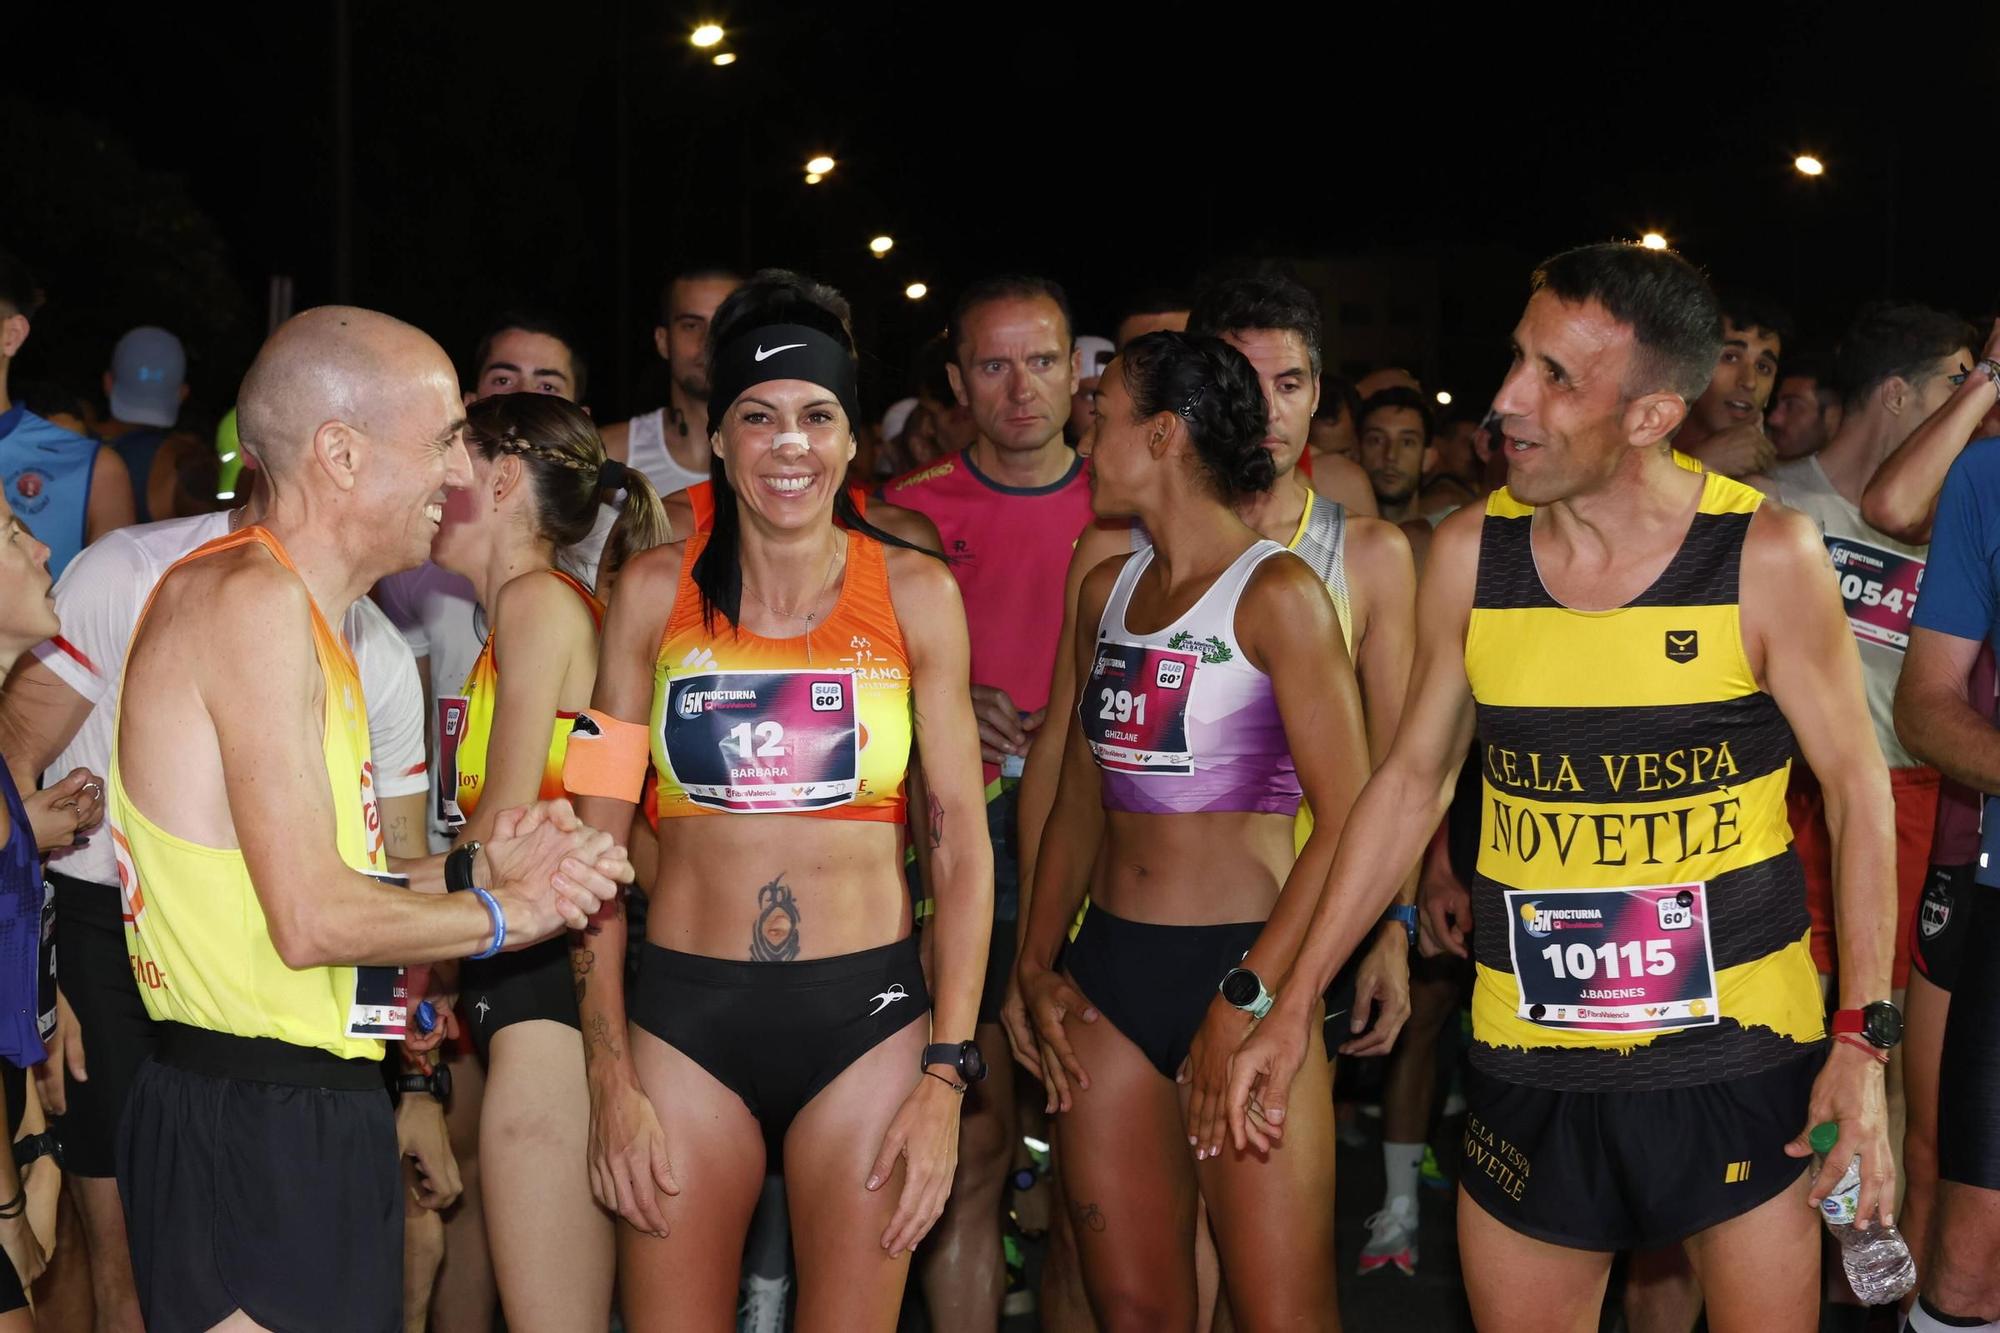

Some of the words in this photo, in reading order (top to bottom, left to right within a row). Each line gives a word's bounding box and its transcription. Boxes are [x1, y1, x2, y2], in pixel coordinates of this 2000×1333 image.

[1182, 644, 1218, 653] ALBACETE
[1160, 663, 1183, 673] SUB
[1159, 674, 1181, 684] 60'
[814, 685, 839, 694] SUB
[680, 691, 704, 714] 15K
[704, 690, 757, 700] NOCTURNA
[815, 696, 840, 706] 60'
[1100, 688, 1147, 725] 291
[730, 721, 785, 758] 12
[1104, 729, 1139, 743] GHIZLANE
[1600, 741, 1740, 792] VESPA
[731, 767, 789, 779] BARBARA
[1490, 785, 1742, 867] NOVETLÈ
[1552, 909, 1602, 920] NOCTURNA
[1542, 939, 1677, 980] 10115
[393, 986, 405, 998] LUIS
[1580, 987, 1646, 999] J.BADENES
[1586, 1010, 1630, 1019] FibraValencia
[1501, 1140, 1531, 1178] VESPA
